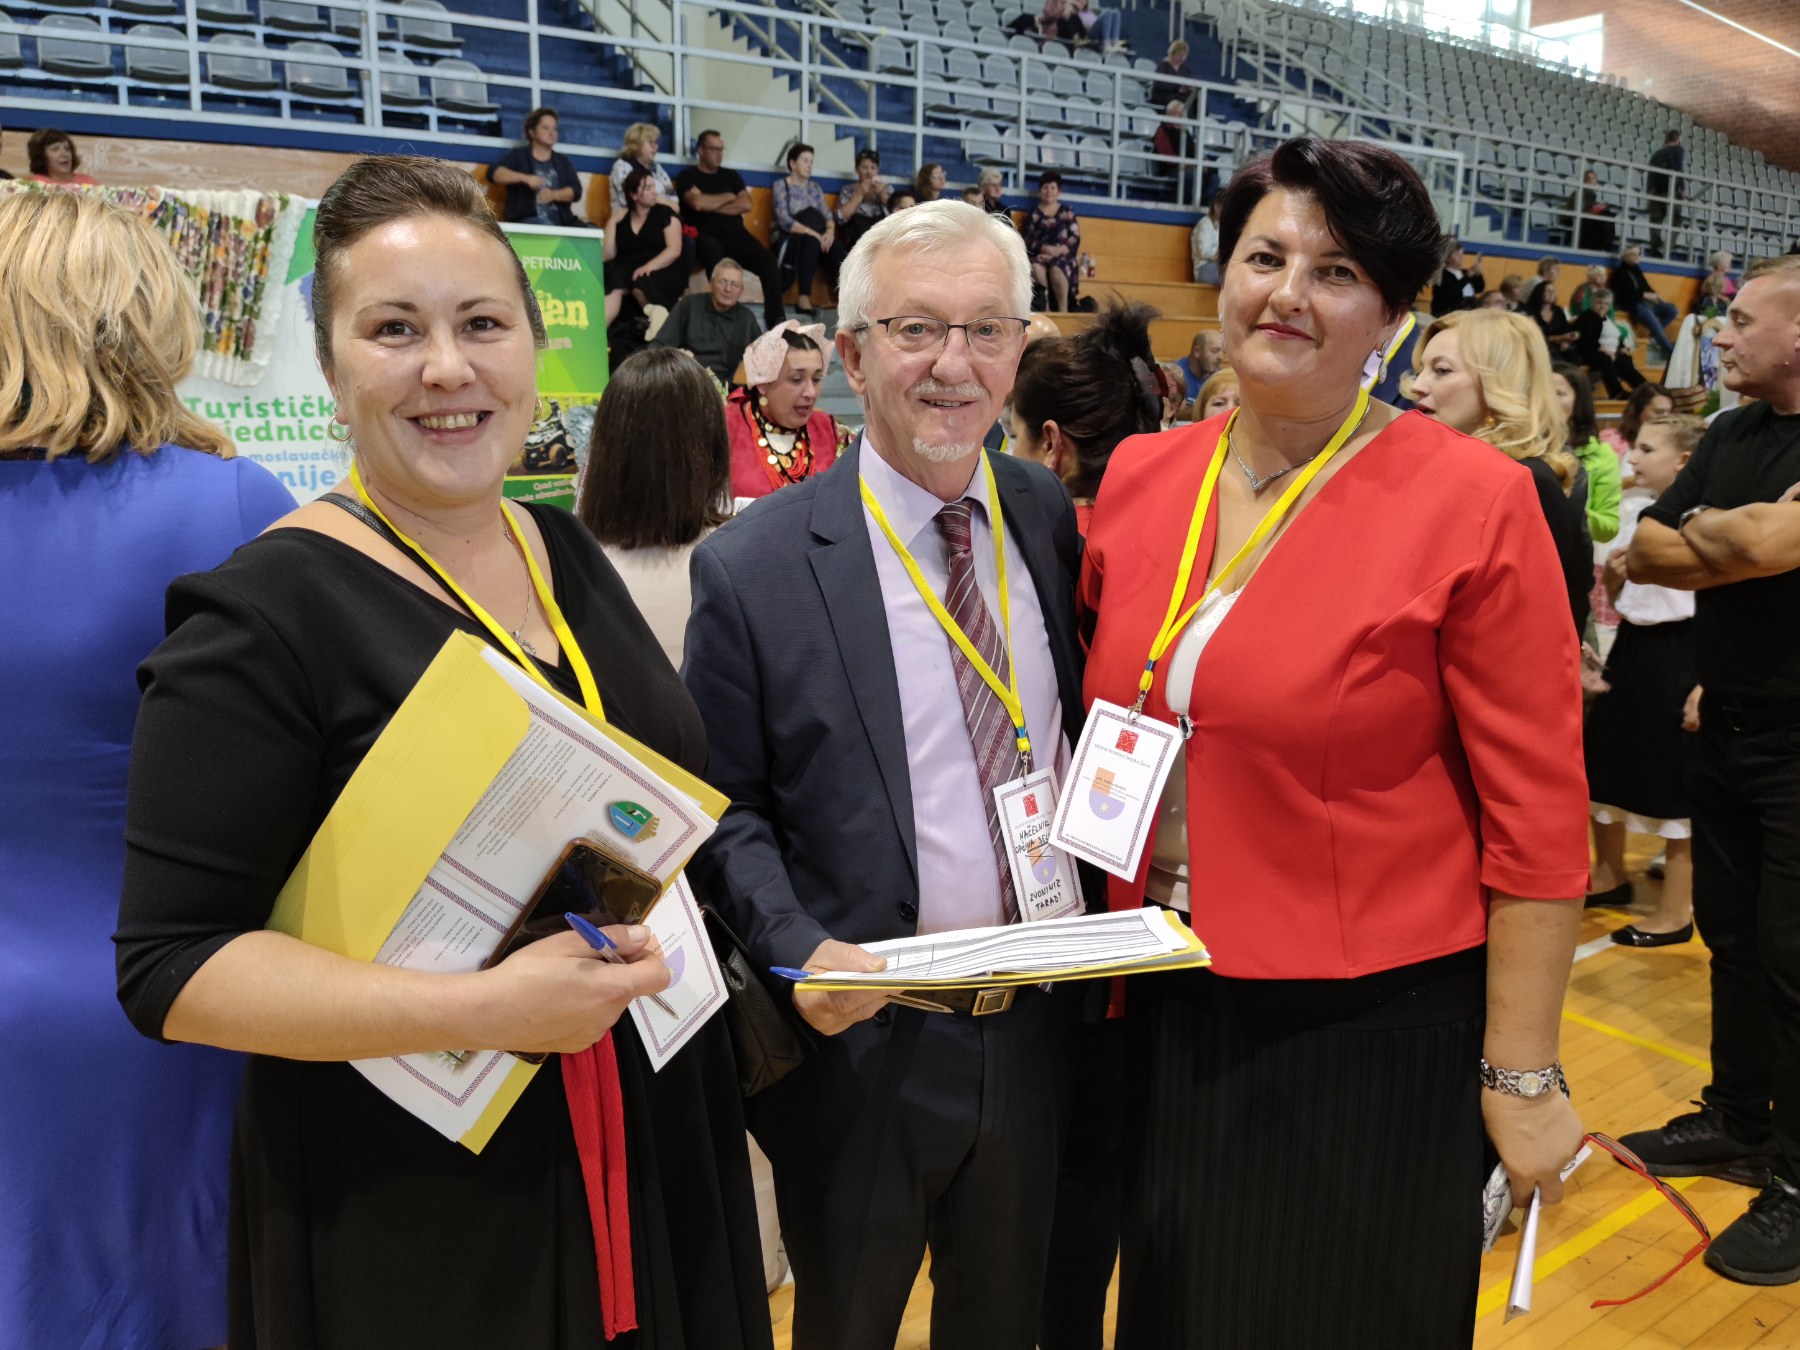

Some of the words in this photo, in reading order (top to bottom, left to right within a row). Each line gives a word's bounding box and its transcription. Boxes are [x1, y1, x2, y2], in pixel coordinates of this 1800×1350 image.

[523, 255, 582, 271] PETRINJA
[183, 395, 337, 419] Turističk
[249, 449, 341, 462] moslavačk
[277, 464, 336, 491] nije
[1019, 820, 1050, 840] NAČELNIK
